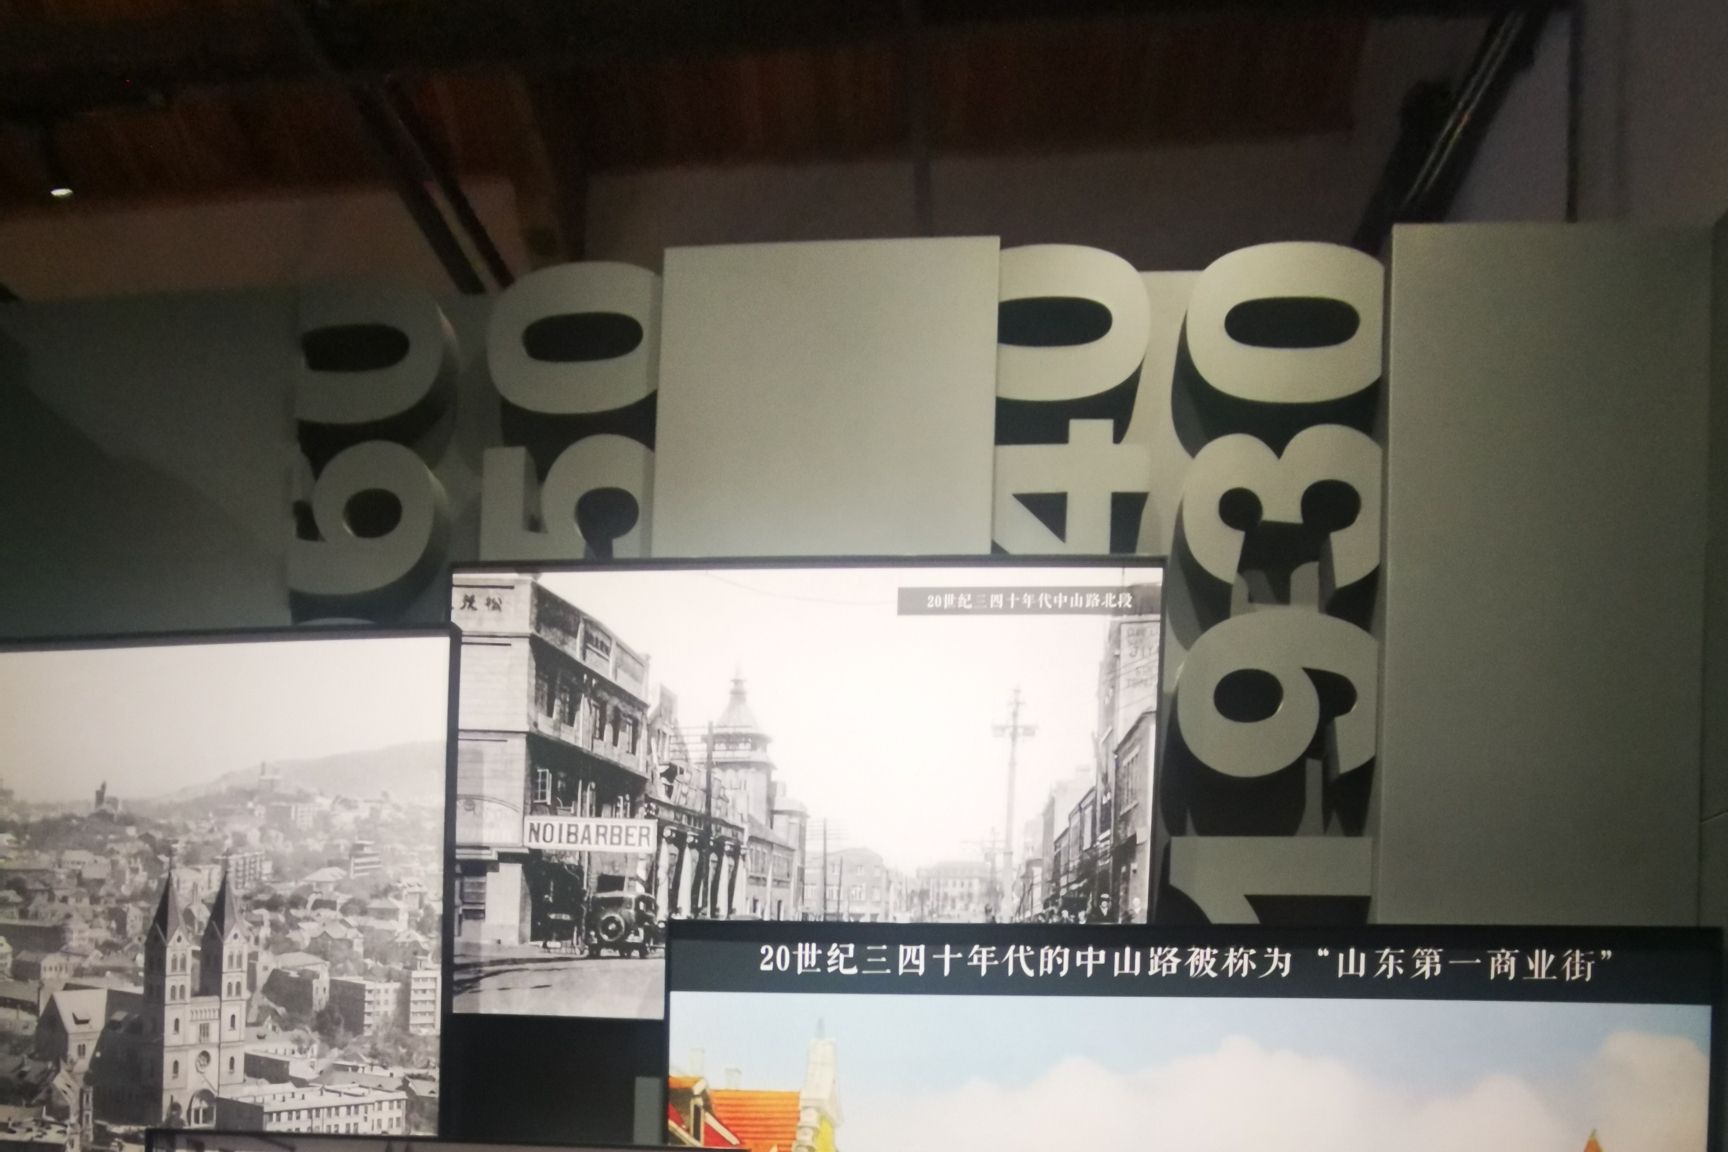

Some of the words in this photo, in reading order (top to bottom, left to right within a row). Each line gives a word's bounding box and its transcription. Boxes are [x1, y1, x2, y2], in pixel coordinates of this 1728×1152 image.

[480, 261, 662, 561] 50
[994, 243, 1151, 553] 40
[926, 592, 1133, 610] 20世纪三四十年代中山路北段
[1169, 241, 1384, 924] 1930
